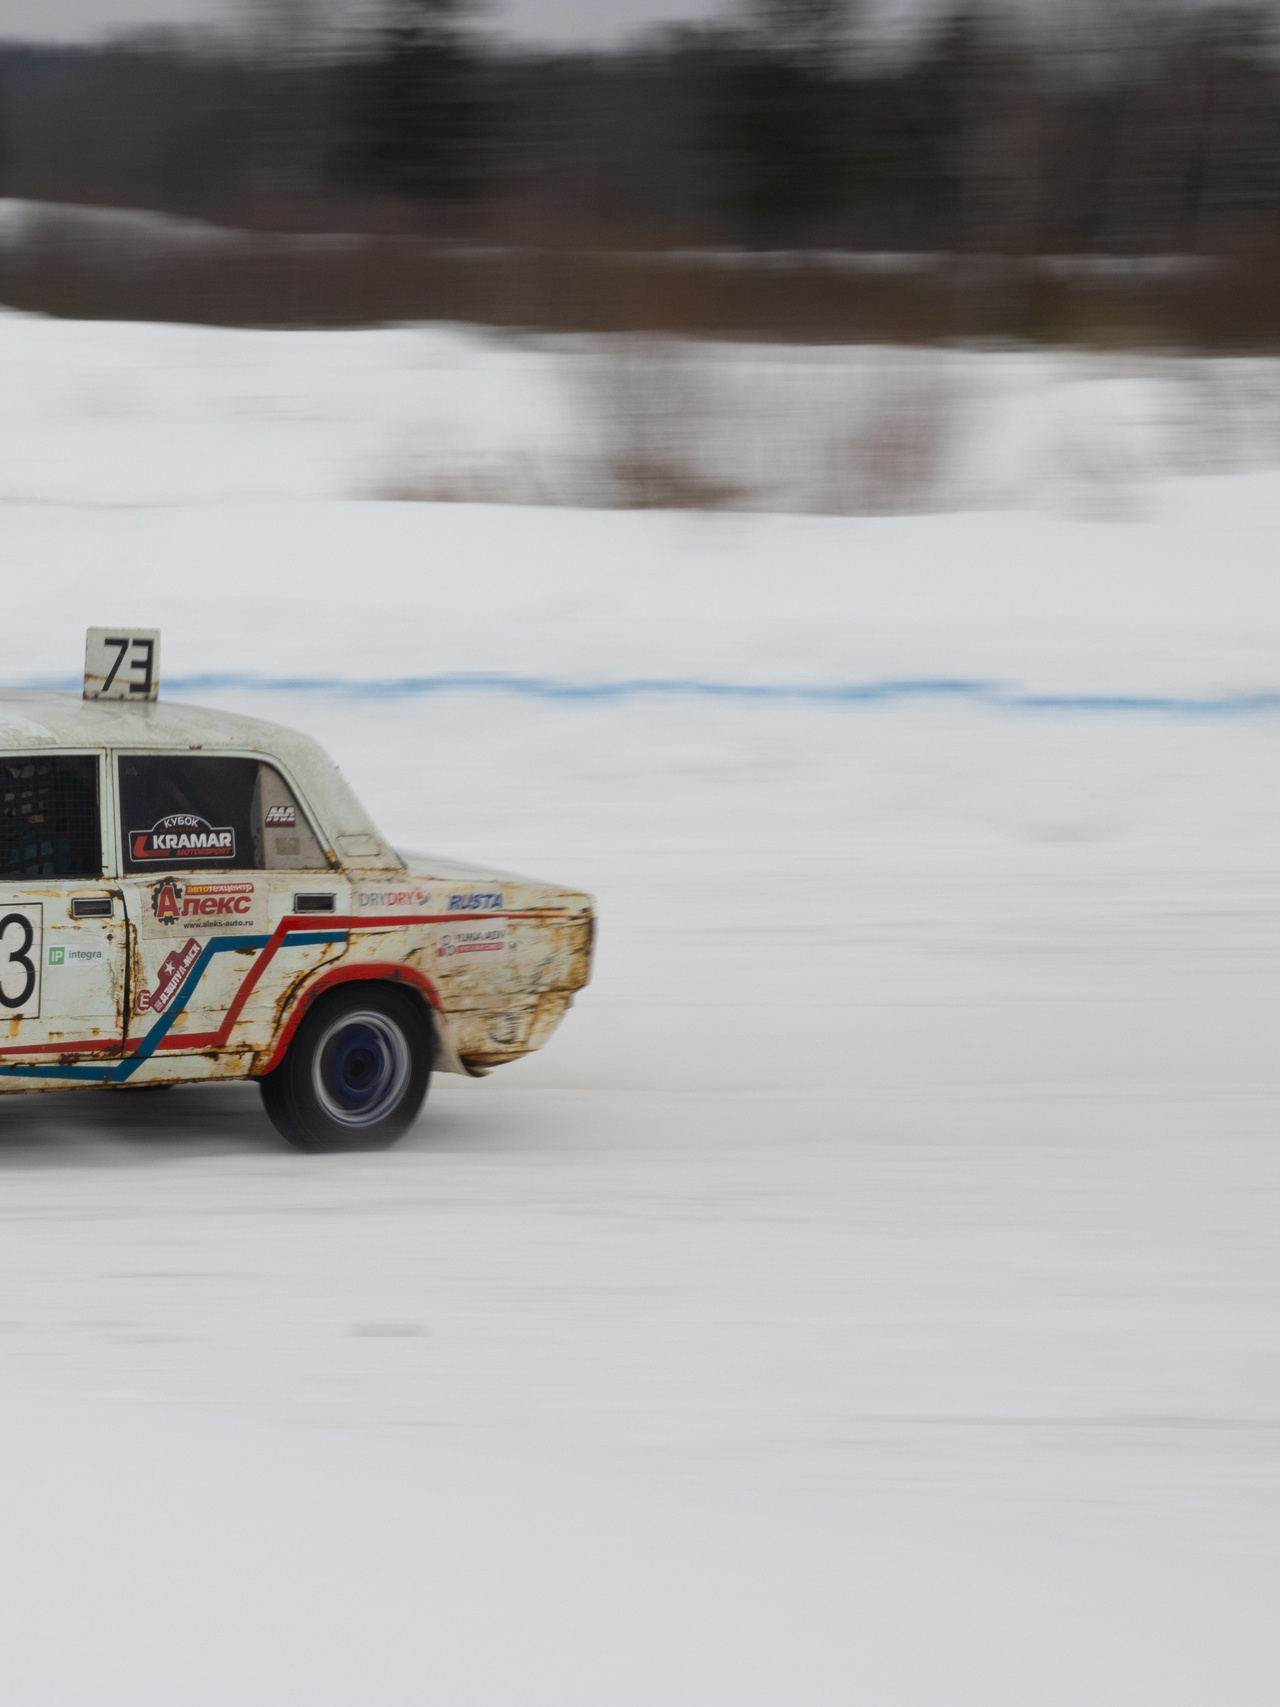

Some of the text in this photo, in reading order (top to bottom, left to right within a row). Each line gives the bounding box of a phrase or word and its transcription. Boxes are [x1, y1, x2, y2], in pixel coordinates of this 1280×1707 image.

[101, 638, 154, 692] 73
[164, 817, 199, 828] КУБОК
[153, 832, 232, 850] KRAMAR
[176, 847, 231, 856] MOTORSPORT
[187, 884, 253, 893] автотехцентр
[157, 886, 251, 917] Алекс
[359, 892, 414, 906] DRYDRY
[447, 893, 503, 911] RUSTA
[183, 919, 253, 929] www.aleks-auto.ru
[51, 950, 102, 962] IP integra
